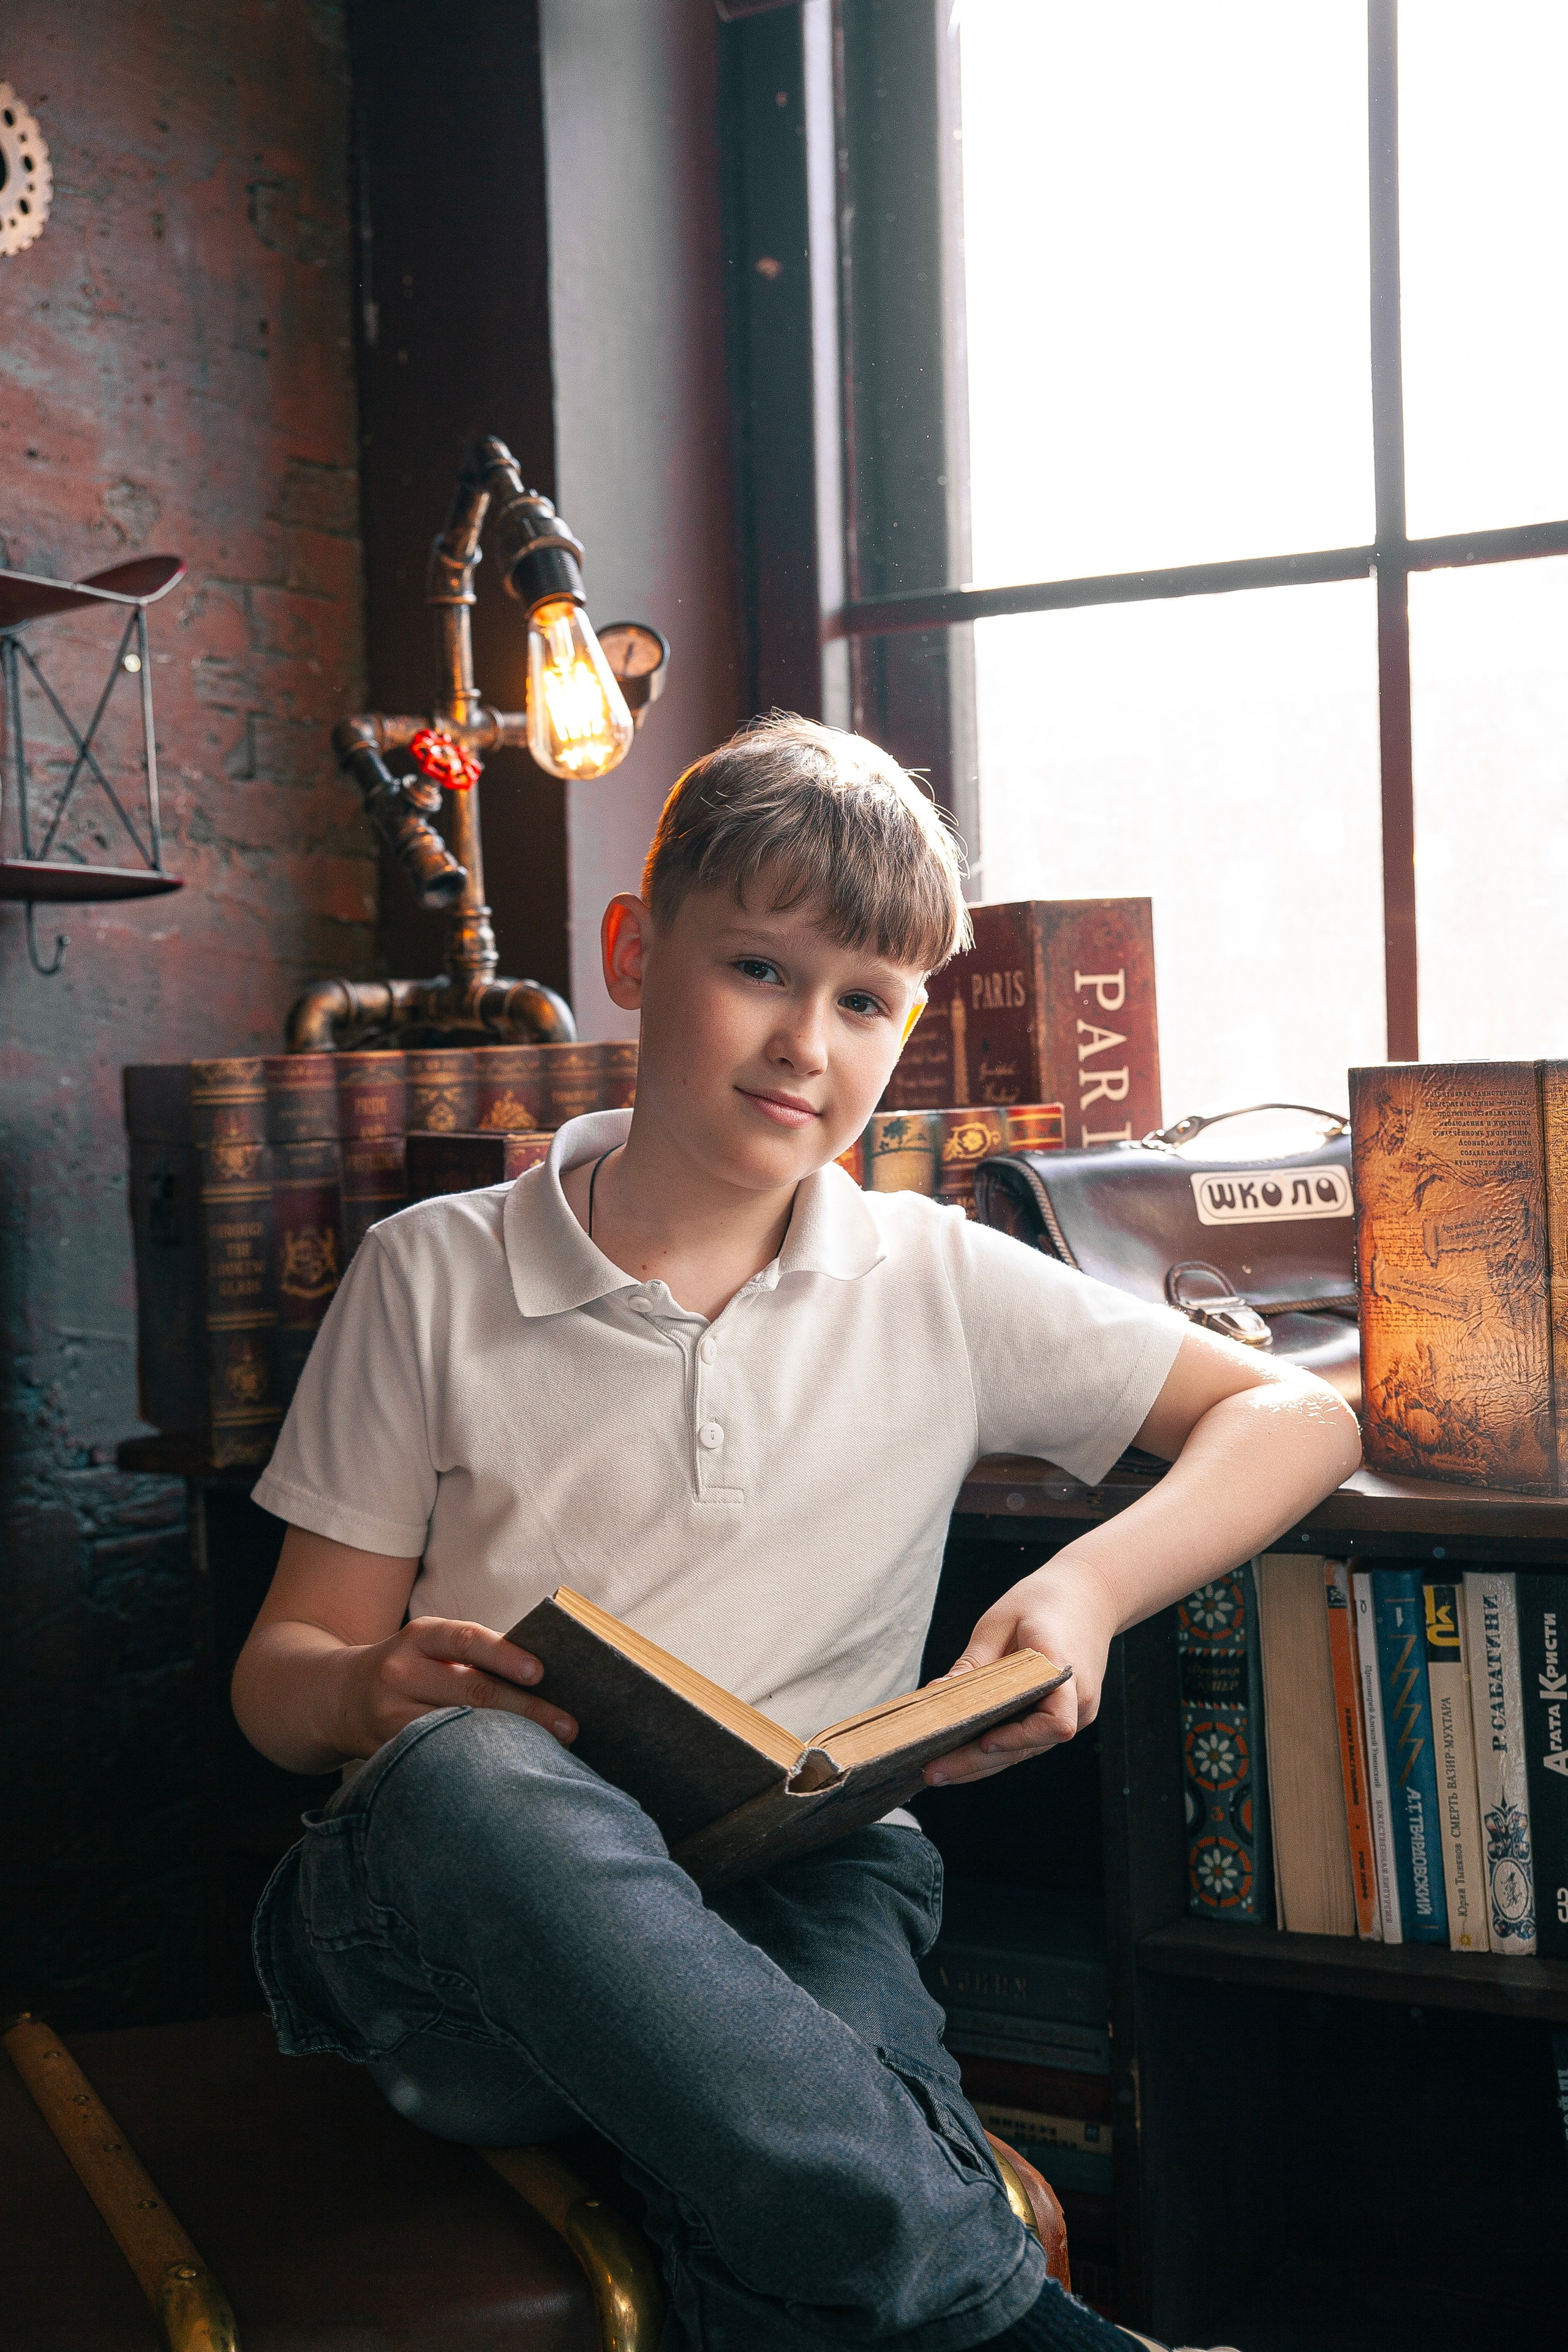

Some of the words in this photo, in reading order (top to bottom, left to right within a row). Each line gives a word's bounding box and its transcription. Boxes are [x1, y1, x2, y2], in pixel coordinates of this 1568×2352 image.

[971, 970, 1026, 1010] PARIS
[1474, 1090, 1529, 1099] единственным
[1454, 1159, 1496, 1168] культурное
[1458, 1139, 1494, 1148] Леонардо
[1207, 1177, 1338, 1210] ШКОЛА
[1482, 1594, 1507, 1732] САБАТИНИ
[1539, 1613, 1568, 1700] Кристи
[1441, 1696, 1457, 1789] ВАЗИР-МУХТАРА
[1492, 1734, 1508, 1754] Р.
[1449, 1793, 1461, 1838] СМЕРТЬ
[1409, 1815, 1431, 1915] ТВАРДОВСКИЙ
